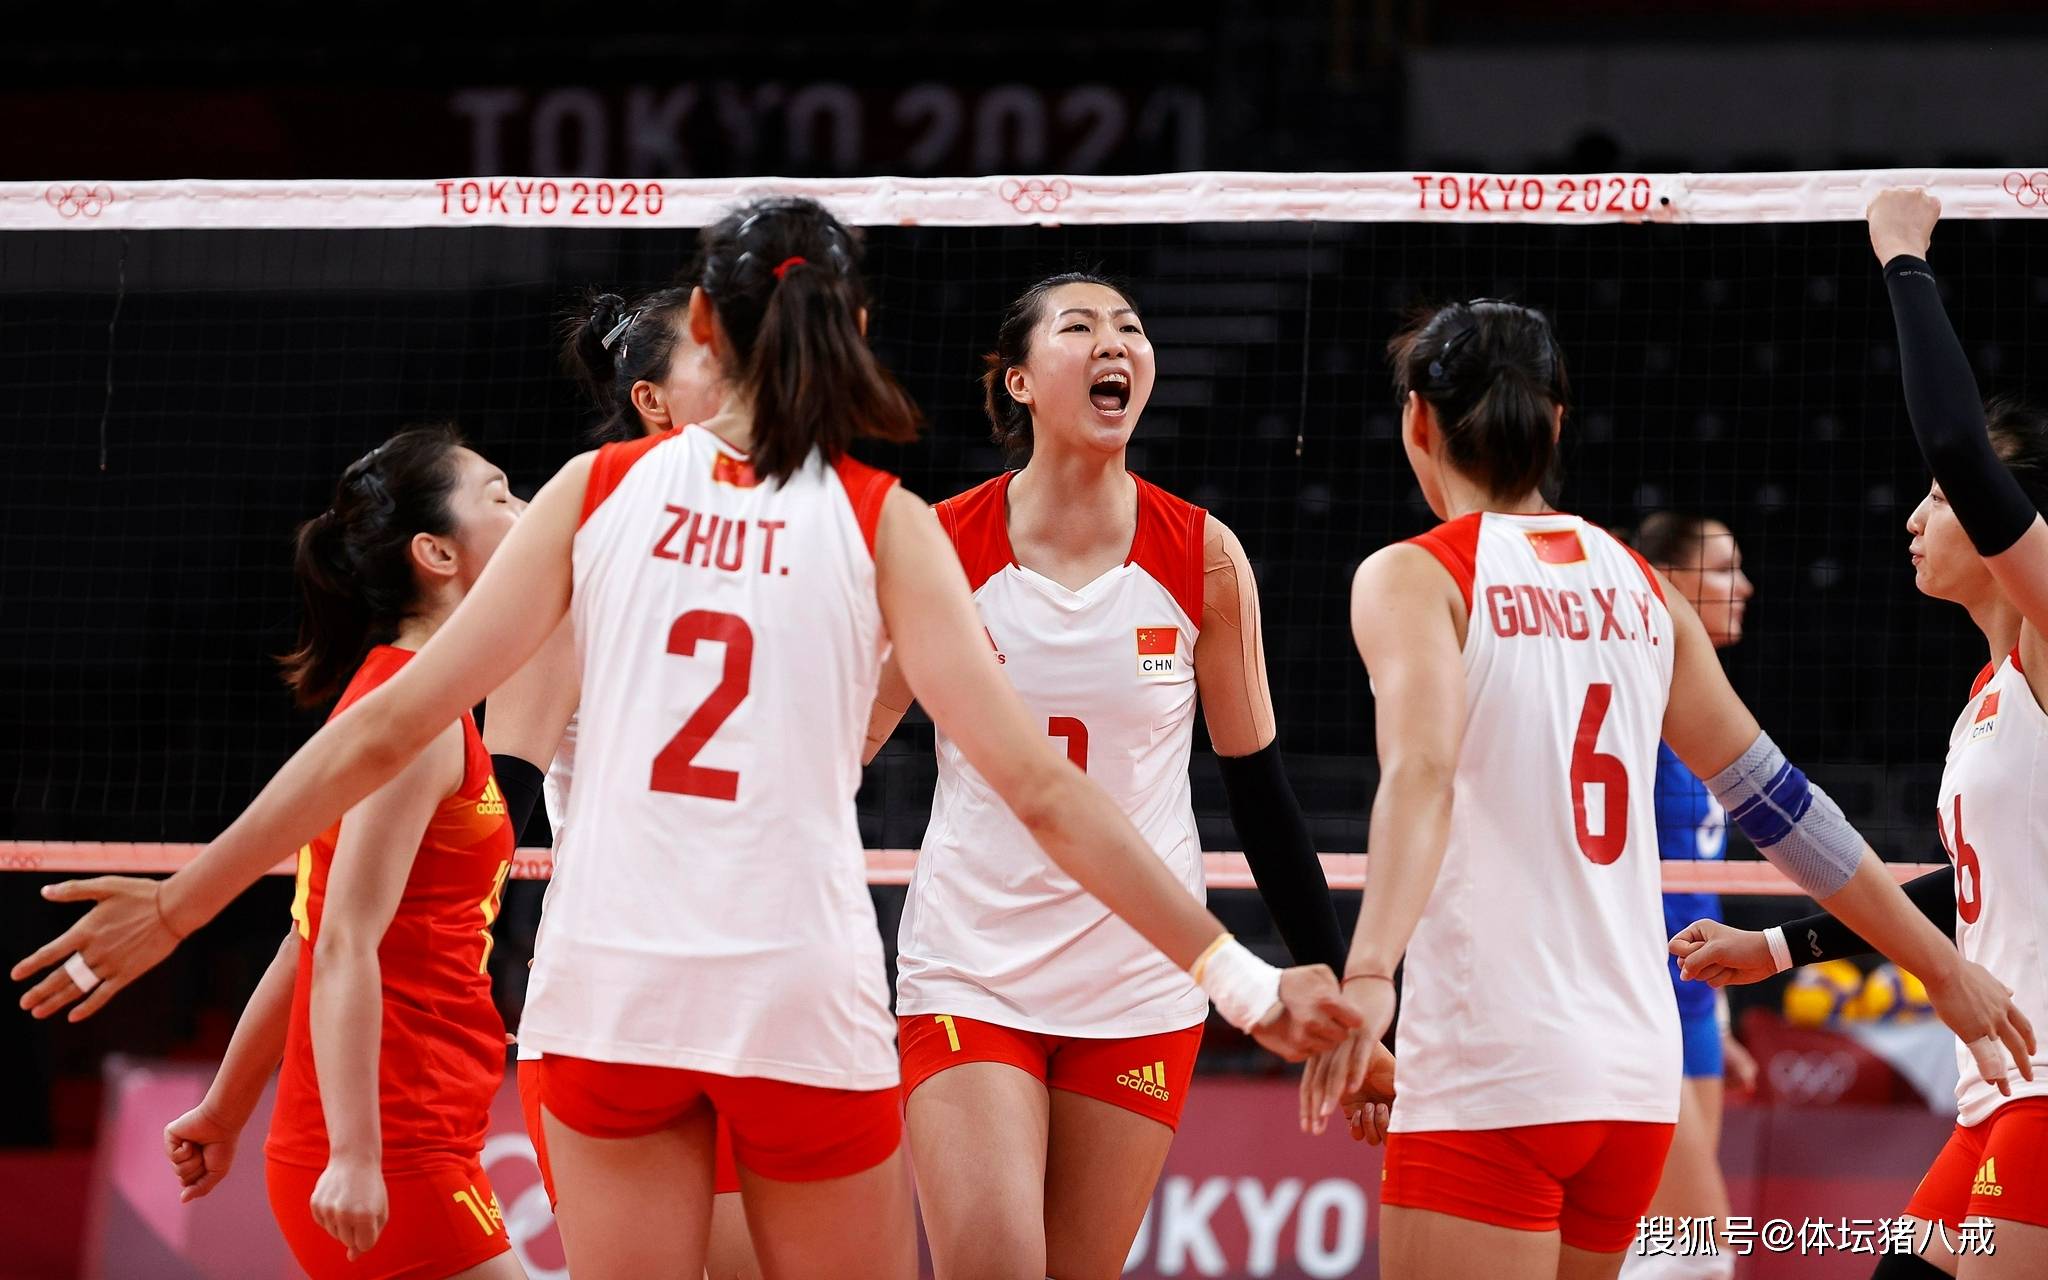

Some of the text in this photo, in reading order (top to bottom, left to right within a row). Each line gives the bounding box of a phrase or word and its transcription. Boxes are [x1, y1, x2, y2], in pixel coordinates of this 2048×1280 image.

[436, 181, 663, 215] TOKYO 2020
[1413, 176, 1650, 212] TOKYO 2020
[652, 504, 789, 576] ZHU T.
[1485, 584, 1590, 641] GONG
[1142, 658, 1172, 671] CHN
[649, 609, 754, 801] 2
[1972, 720, 1994, 738] CHN
[1570, 683, 1628, 865] 6
[934, 1014, 961, 1052] 1
[1116, 1071, 1170, 1102] adidas
[1122, 1175, 1368, 1279] KYO
